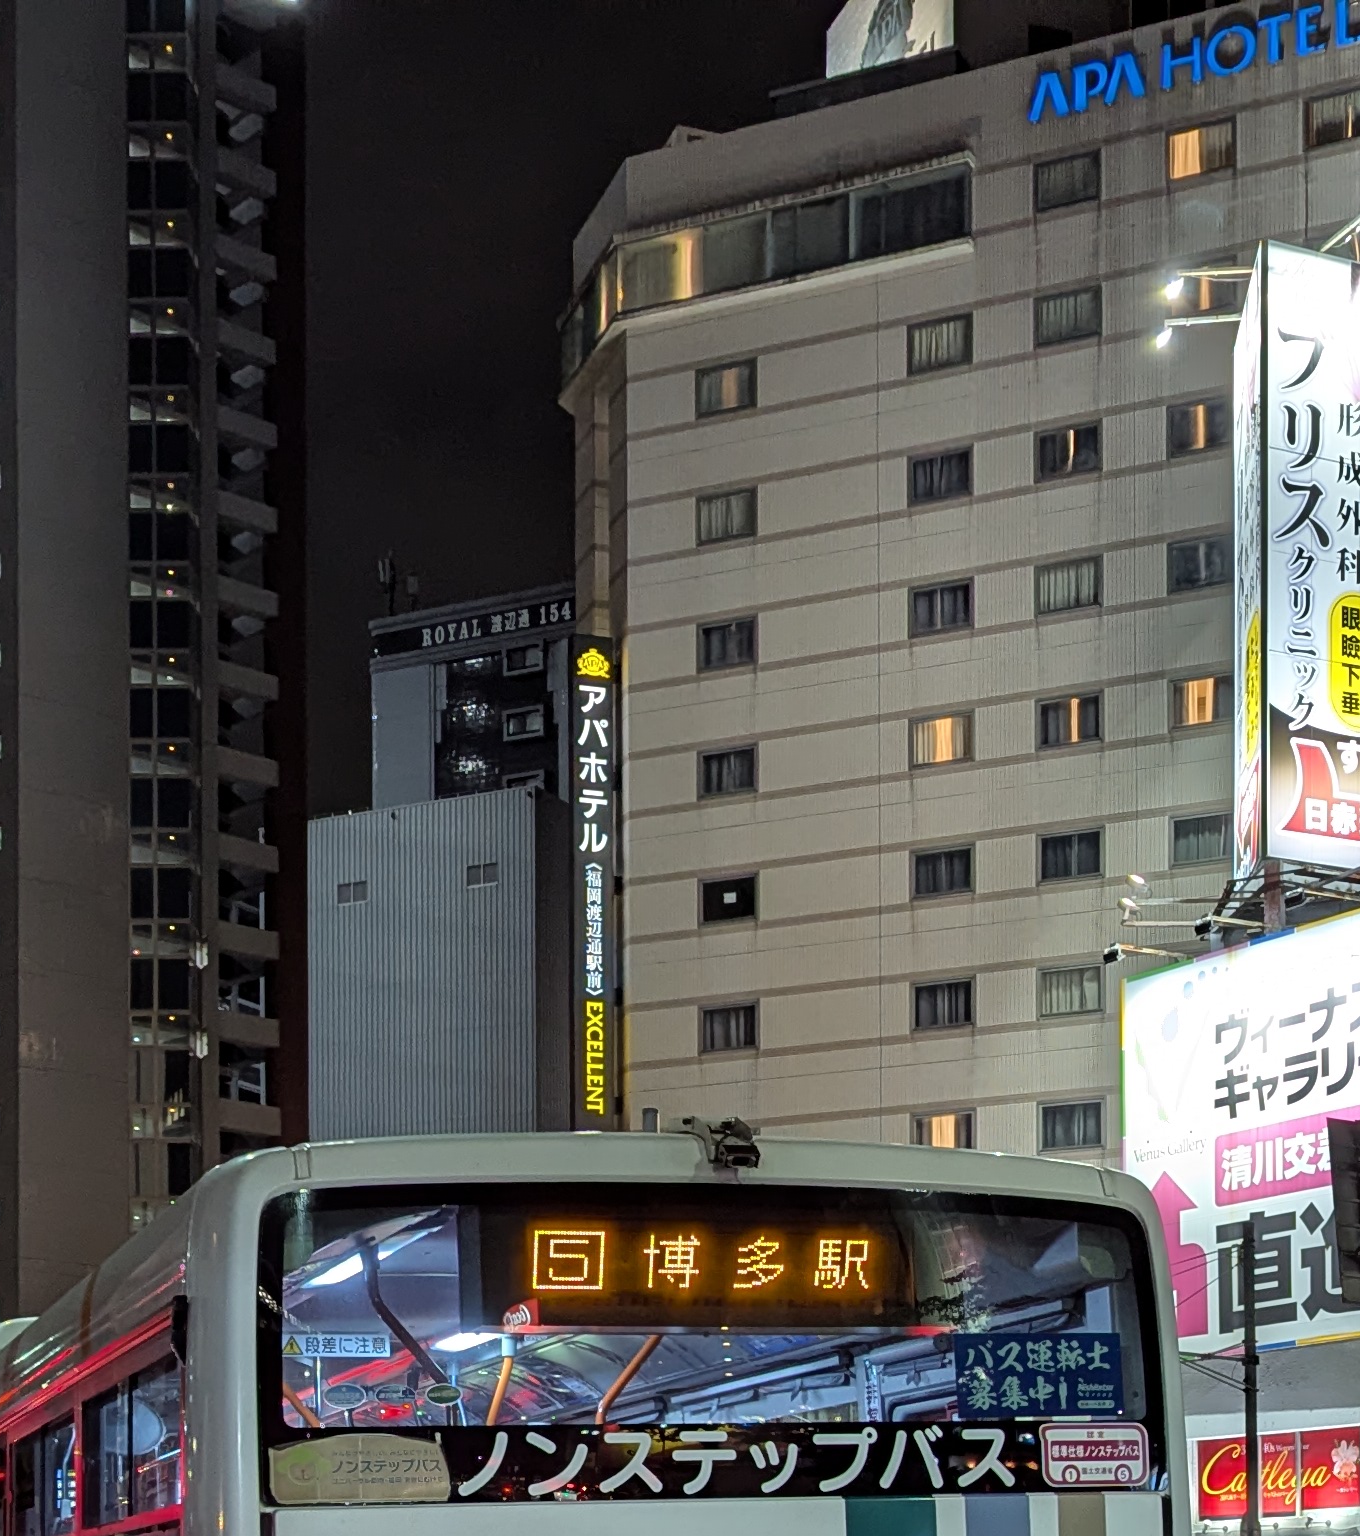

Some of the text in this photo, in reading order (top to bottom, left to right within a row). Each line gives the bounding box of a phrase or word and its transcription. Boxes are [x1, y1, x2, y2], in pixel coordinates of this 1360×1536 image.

[1028, 52, 1146, 124] APA
[421, 618, 482, 647] ROYAL
[539, 600, 572, 625] 154
[577, 684, 609, 855] アパホテル
[585, 1001, 604, 1115] EXCELLENT
[1133, 1129, 1208, 1164] Venus Gallery
[548, 1233, 870, 1291] 5 博多駅
[305, 1336, 388, 1355] 段差に注意
[965, 1339, 1111, 1374] バス運転士
[966, 1375, 1056, 1411] 募集中
[332, 1459, 443, 1474] ノンステップバス
[459, 1430, 1016, 1496] ノンステップバス
